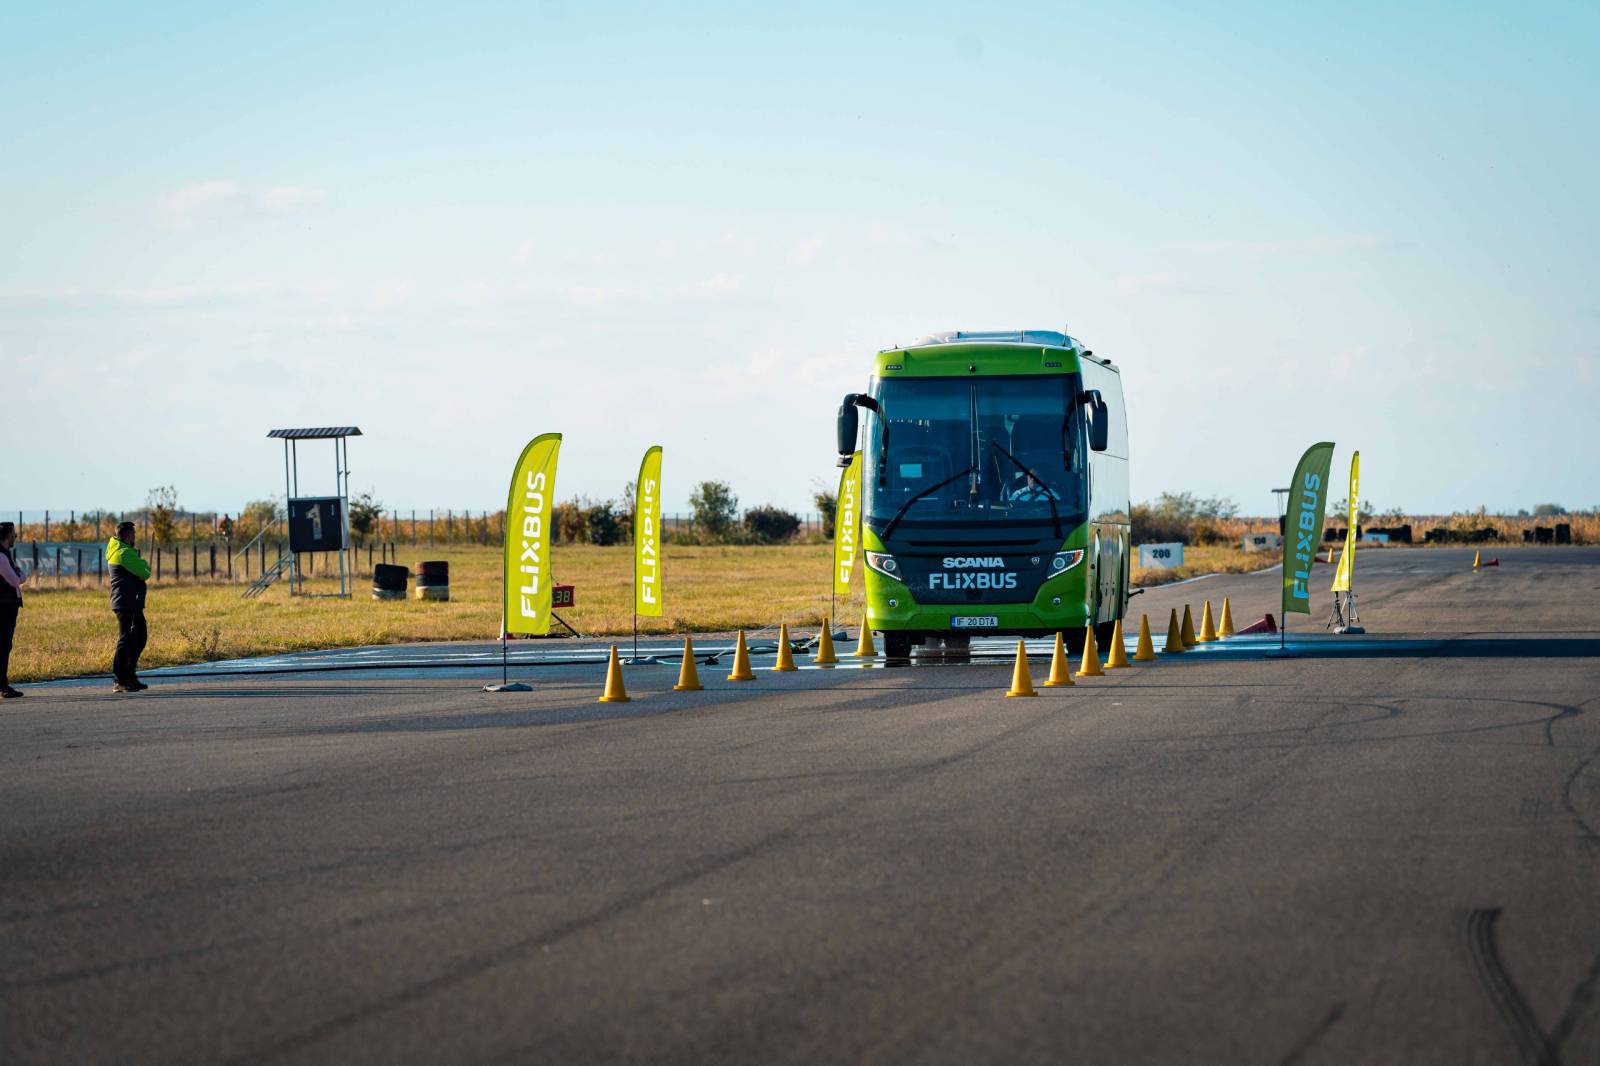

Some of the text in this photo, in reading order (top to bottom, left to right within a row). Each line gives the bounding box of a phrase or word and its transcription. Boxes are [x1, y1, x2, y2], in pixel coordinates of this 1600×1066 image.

[305, 504, 322, 540] 1
[1152, 549, 1171, 559] 200
[943, 557, 1005, 568] SCANIA
[929, 572, 1017, 589] FLiXBUS
[957, 617, 995, 626] IF 20 DTA
